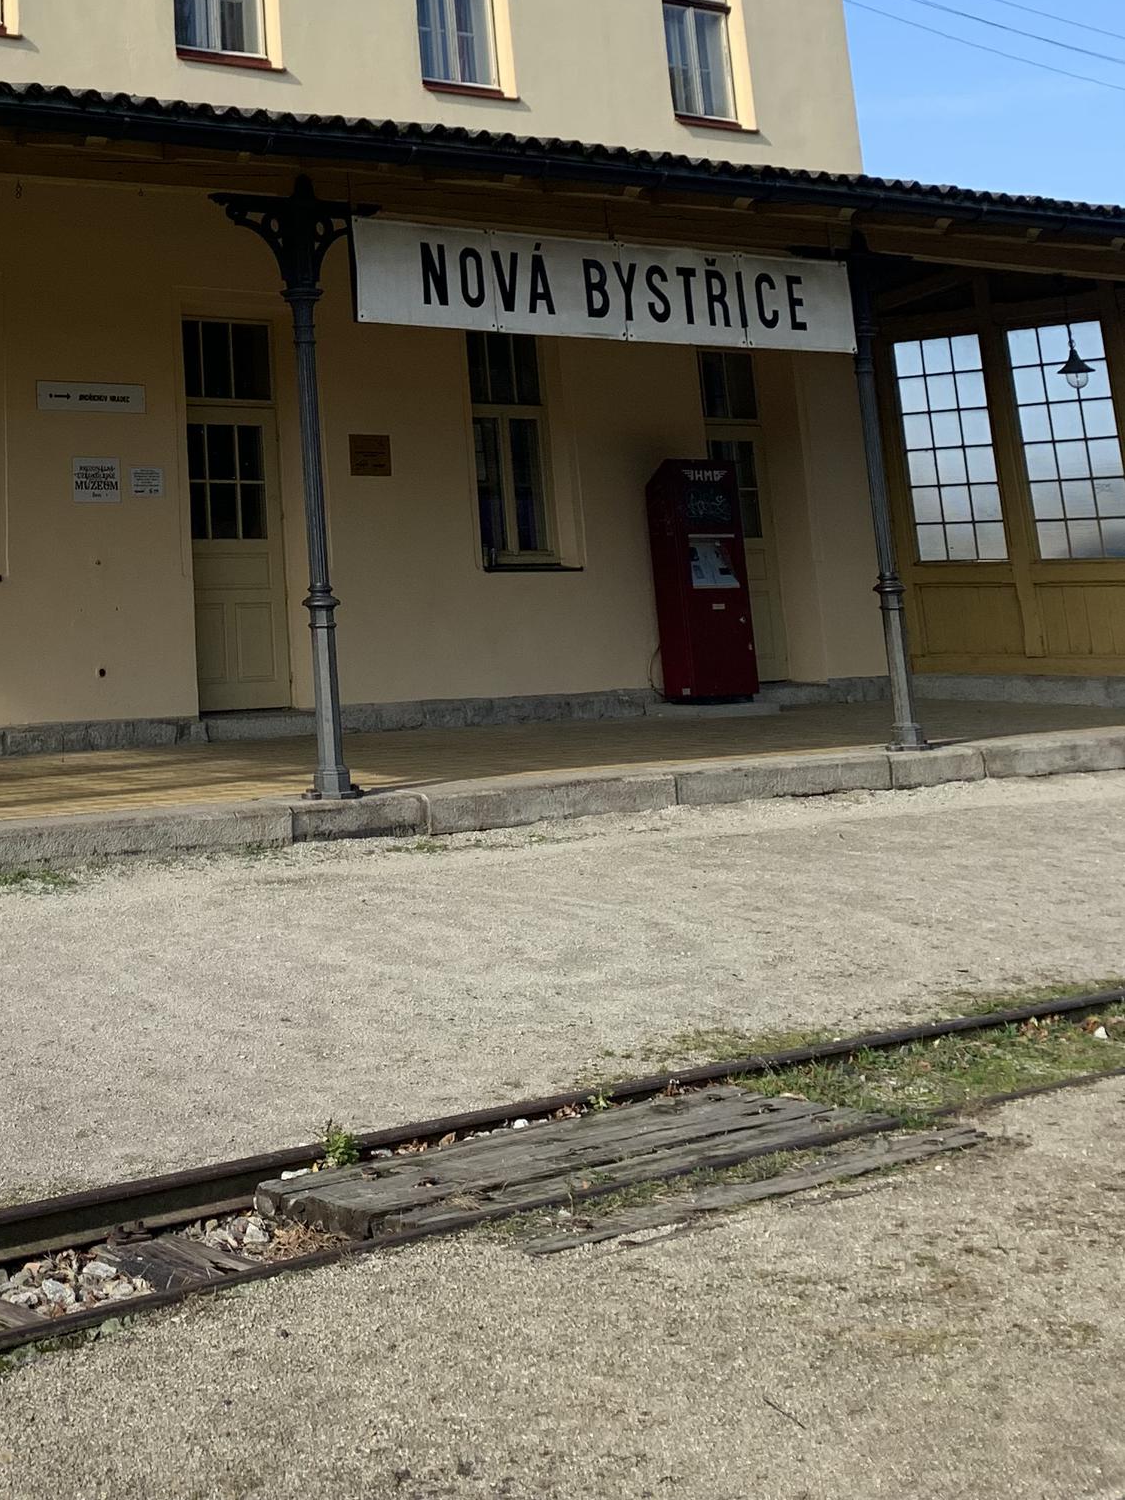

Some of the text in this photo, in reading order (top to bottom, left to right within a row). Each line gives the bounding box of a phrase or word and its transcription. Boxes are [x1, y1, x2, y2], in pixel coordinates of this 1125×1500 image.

[419, 242, 808, 331] NOVÁ BYSTŘICE
[74, 480, 119, 491] MUZEUM
